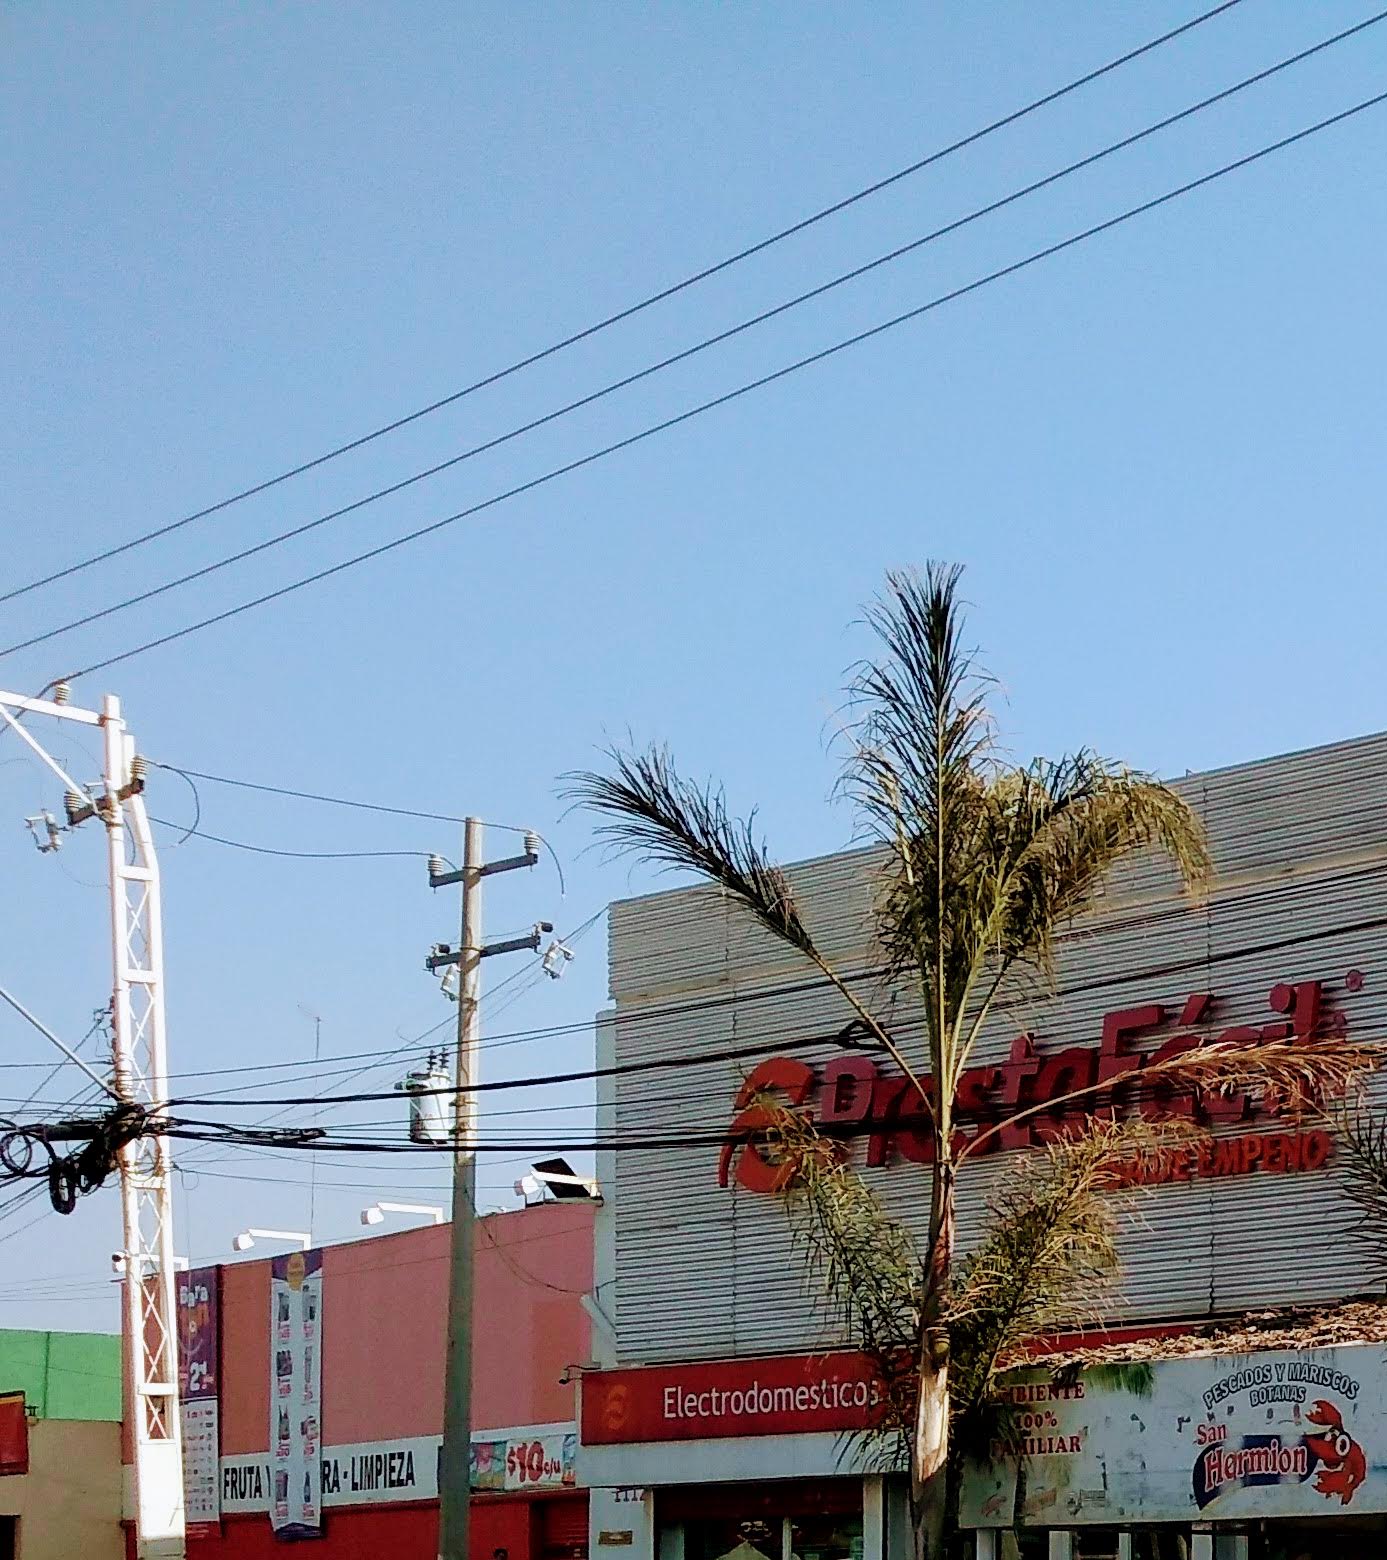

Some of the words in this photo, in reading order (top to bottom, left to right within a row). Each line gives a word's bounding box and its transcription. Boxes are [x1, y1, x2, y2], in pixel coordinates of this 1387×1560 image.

[664, 1376, 878, 1419] Electrodomesticos
[996, 1381, 1085, 1405] MBIENTE
[1203, 1364, 1272, 1410] PESCADOS
[1275, 1363, 1286, 1382] Y
[1288, 1362, 1360, 1400] MARISCOS
[1249, 1384, 1307, 1407] BOTANAS
[1015, 1410, 1058, 1430] 100%
[1195, 1423, 1227, 1446] San
[223, 1466, 263, 1500] FRUTA
[351, 1450, 416, 1492] LIMPIEZA
[507, 1441, 545, 1483] $10
[1204, 1438, 1308, 1493] Hermion
